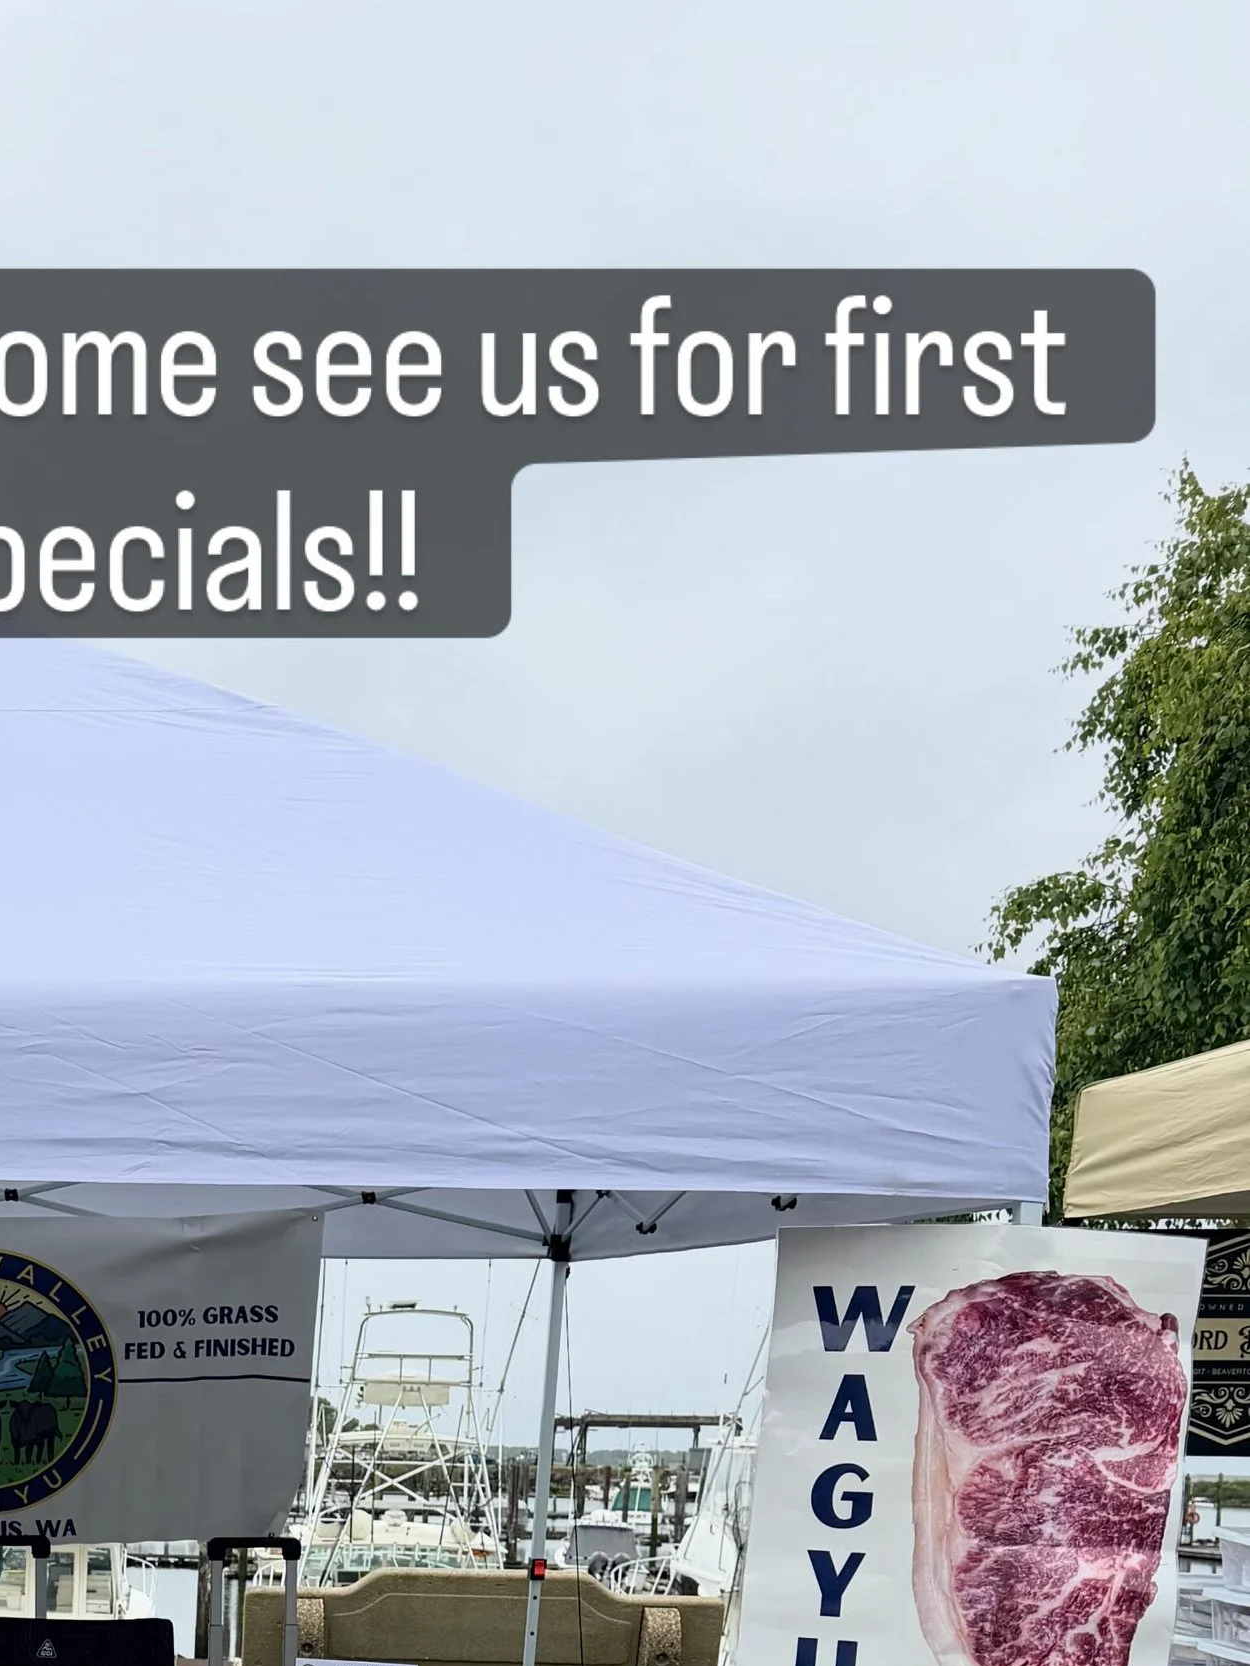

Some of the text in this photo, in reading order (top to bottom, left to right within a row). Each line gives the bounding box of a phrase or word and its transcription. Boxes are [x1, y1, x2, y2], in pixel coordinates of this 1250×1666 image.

[137, 1305, 279, 1328] 100% GRASS
[124, 1337, 295, 1360] FED & FINISHED
[35, 1518, 77, 1537] WA
